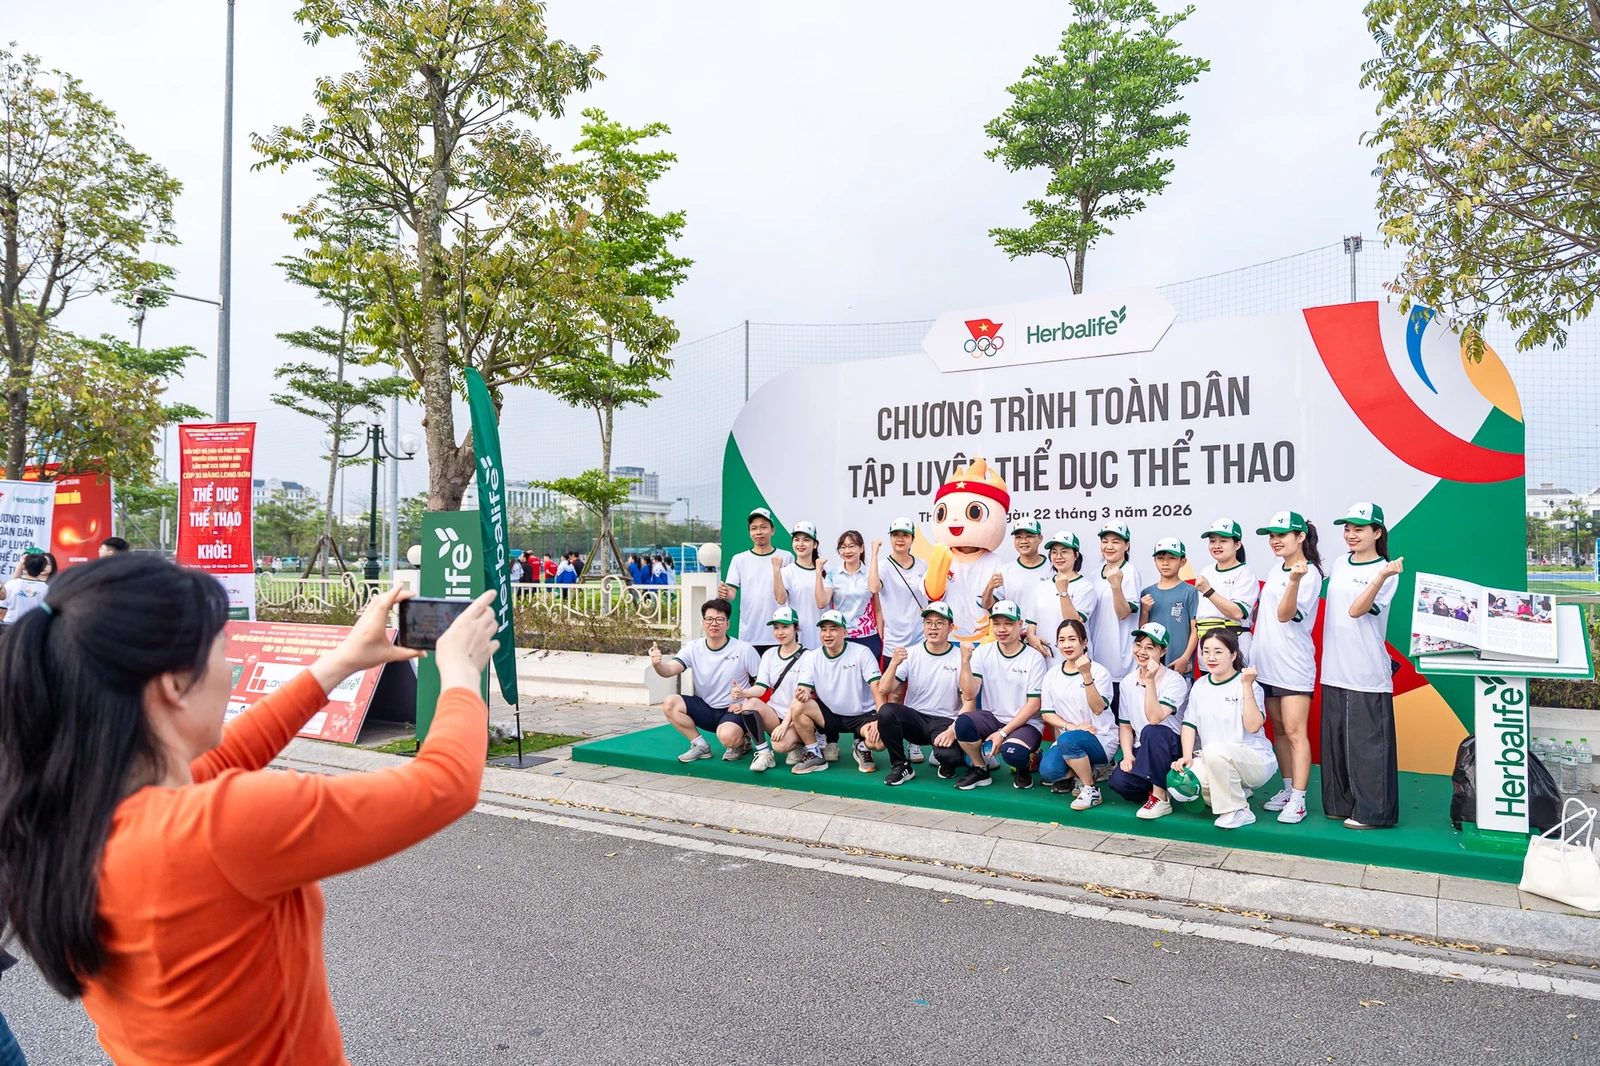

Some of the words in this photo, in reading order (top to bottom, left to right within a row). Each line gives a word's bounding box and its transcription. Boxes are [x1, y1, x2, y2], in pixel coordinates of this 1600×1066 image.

[1026, 311, 1118, 345] Herbalife
[877, 400, 982, 441] CHƯƠNG
[990, 388, 1076, 433] TRÌNH
[1086, 377, 1169, 427] TOÀN
[1181, 370, 1251, 420] DÂN
[848, 457, 895, 505] TẬP
[902, 452, 987, 496] LUY
[995, 438, 1053, 492] THỂ
[1059, 450, 1118, 497] DỤC
[1128, 430, 1194, 487] THỂ
[1200, 440, 1295, 484] THAO
[12, 496, 46, 505] Herbalife
[193, 481, 214, 502] THỂ
[216, 486, 239, 505] DỤC
[22, 513, 46, 526] TRÌNH
[189, 506, 211, 527] THỂ
[213, 511, 242, 527] THAO
[1033, 508, 1051, 520] 22
[1055, 507, 1097, 522] tháng
[1102, 506, 1111, 518] 3
[1115, 505, 1147, 518] năm
[1152, 504, 1193, 517] 2026
[0, 525, 15, 537] OÀN
[197, 539, 232, 560] KHỎE!
[489, 467, 509, 633] Herbalife
[1493, 687, 1527, 818] Herbalife
